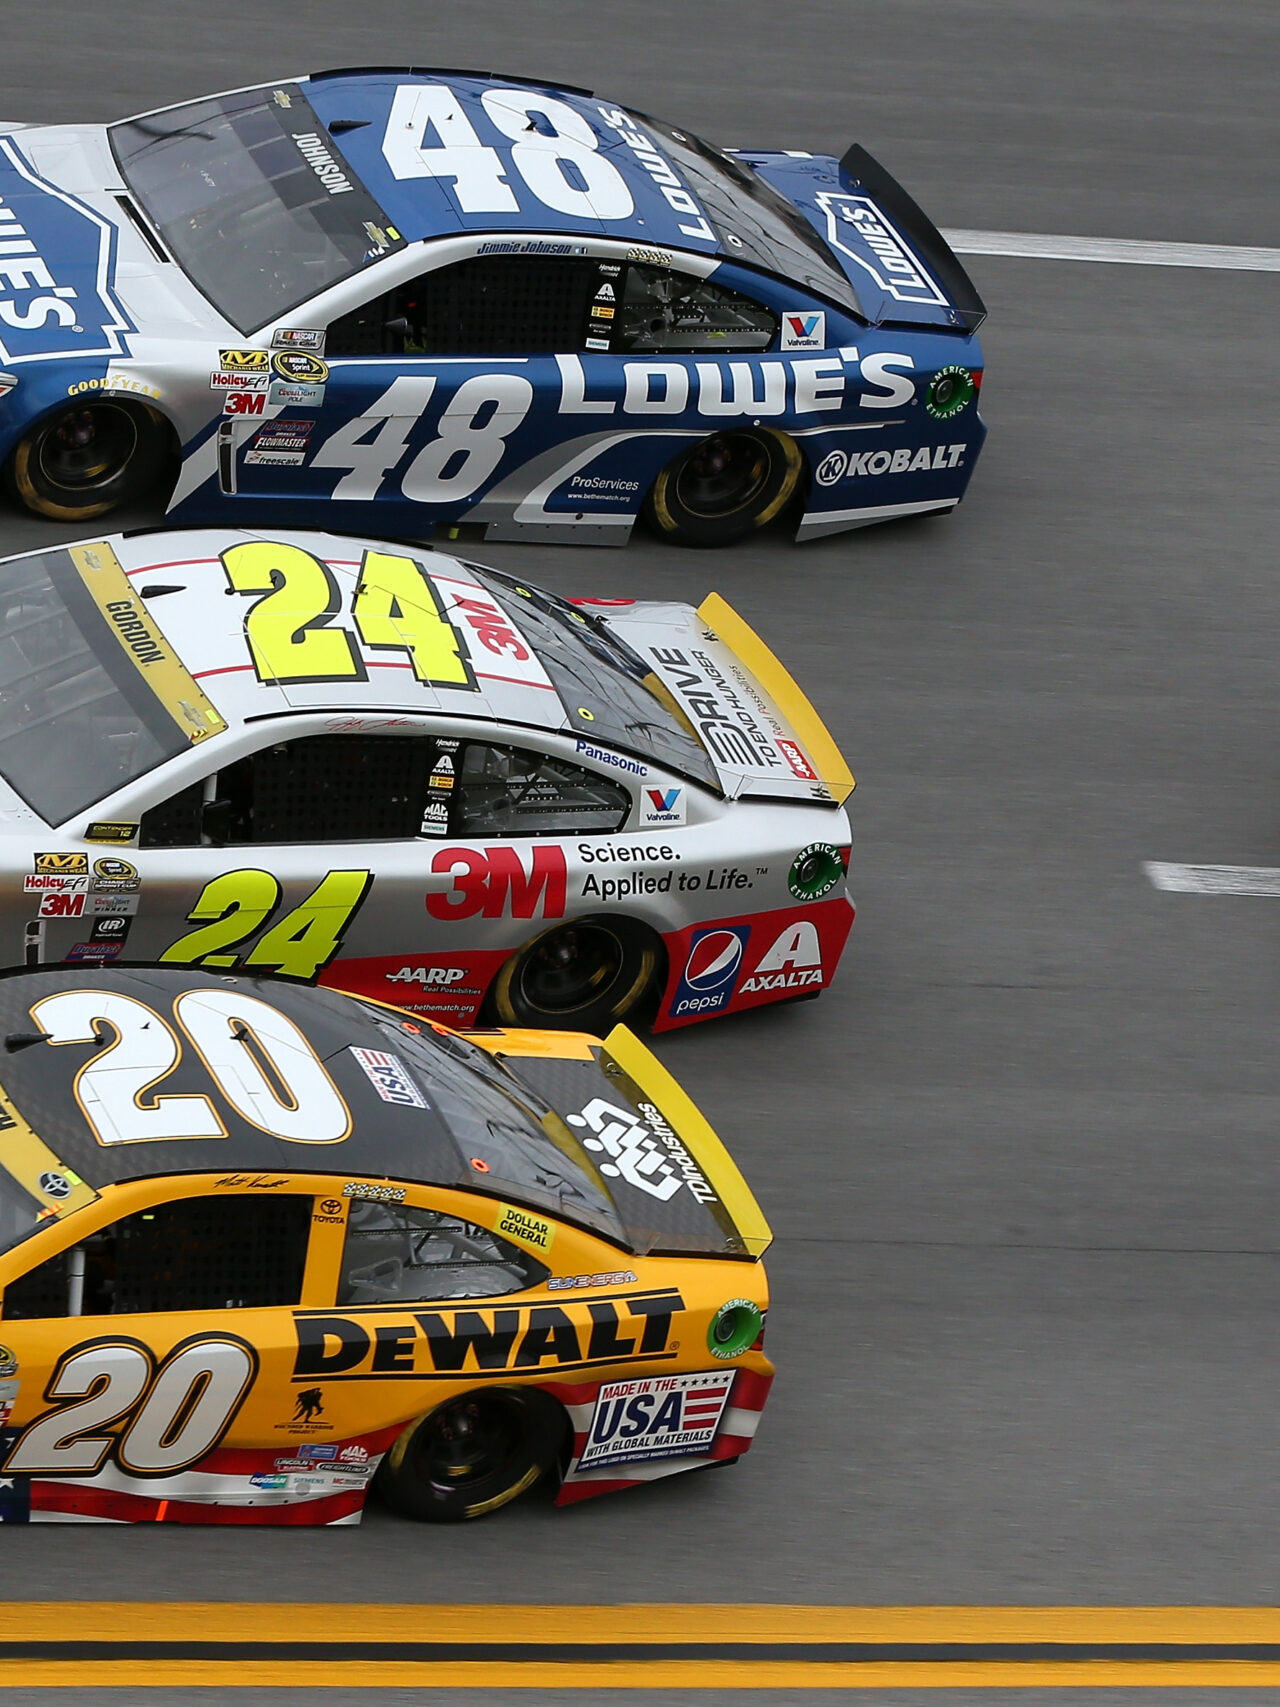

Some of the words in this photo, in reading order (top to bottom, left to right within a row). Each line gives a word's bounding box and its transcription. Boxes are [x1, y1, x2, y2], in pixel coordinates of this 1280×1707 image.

[291, 132, 355, 196] JOHNSON
[382, 84, 635, 221] 48
[598, 105, 717, 243] LOWE'S
[477, 242, 520, 254] Jimmie
[521, 241, 572, 254] Johnson
[842, 205, 928, 290] LOWE'S
[787, 338, 820, 346] Valvoline
[292, 363, 311, 372] Sprint
[930, 366, 974, 389] AMERICAN
[67, 374, 163, 400] GOODYEAR
[212, 374, 248, 388] Holley
[554, 347, 916, 415] LOWE'S
[225, 393, 266, 415] 3M
[926, 400, 970, 420] ETHANOL
[255, 438, 307, 449] FLOWMASTER
[309, 374, 533, 503] 48
[259, 455, 300, 465] freescale
[846, 444, 967, 477] KOBALT
[571, 476, 639, 491] ProServices
[568, 493, 631, 502] www.bethematch.org
[218, 541, 482, 693] 24
[451, 593, 529, 661] 3M
[106, 600, 166, 666] GORDON
[691, 649, 747, 711] HUNGER
[649, 646, 766, 767] DRIVE
[575, 739, 649, 777] Panasonic
[424, 803, 448, 816] MAC
[646, 813, 682, 823] Valvoline
[578, 843, 681, 862] Science.
[793, 842, 841, 870] AMERICAN
[26, 876, 65, 891] Holley
[62, 877, 88, 890] EFI
[425, 845, 567, 921] 3M
[581, 871, 672, 900] Applied
[679, 873, 701, 891] to
[706, 869, 754, 890] Life.
[789, 878, 837, 900] ETHANOL
[41, 894, 86, 916] 3M
[157, 867, 375, 986] 24
[386, 967, 465, 984] AARP
[738, 969, 823, 994] AXALTA
[676, 993, 725, 1014] pepsi
[29, 988, 354, 1148] 20
[372, 1066, 414, 1103] USA
[637, 1102, 718, 1204] TDIndustries
[312, 1214, 345, 1224] TOYOTA
[506, 1209, 549, 1235] DOLLAR
[500, 1220, 547, 1247] GENERAL
[718, 1298, 759, 1318] AMERICAN
[293, 1295, 685, 1375] DEWALT
[710, 1345, 749, 1359] ETHANOL
[602, 1384, 636, 1400] MADE
[637, 1381, 649, 1393] IN
[654, 1378, 678, 1391] THE
[1, 1330, 260, 1478] 20
[593, 1391, 684, 1445] USA
[340, 1446, 368, 1456] MAC
[585, 1443, 610, 1458] WITH
[611, 1436, 650, 1452] GLOBAL
[653, 1430, 712, 1446] MATERIALS
[321, 1464, 366, 1473] FREIGHTLINER
